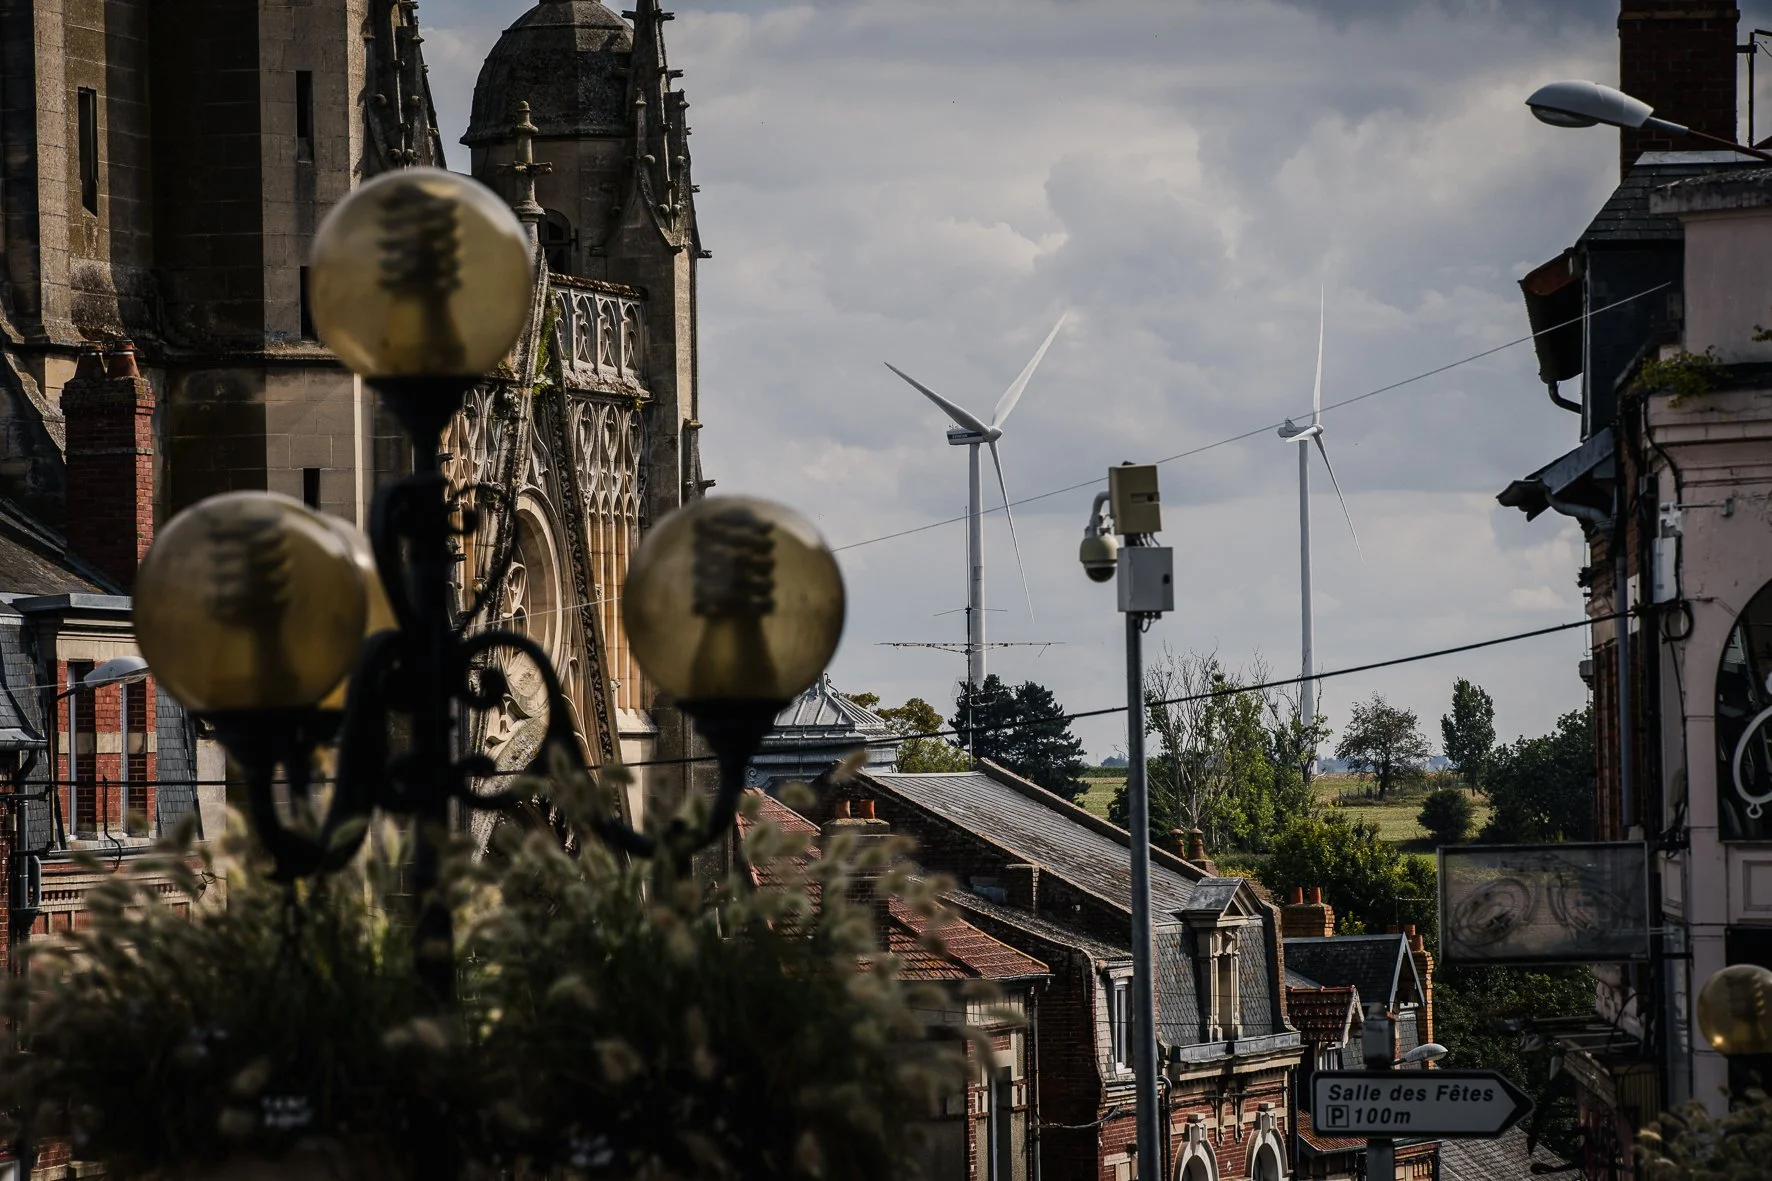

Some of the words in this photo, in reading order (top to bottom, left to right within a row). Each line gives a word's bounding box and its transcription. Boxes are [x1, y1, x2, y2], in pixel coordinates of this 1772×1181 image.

[1328, 1084, 1381, 1101] Salle
[1389, 1084, 1427, 1101] des
[1435, 1084, 1494, 1101] Fêtes
[1331, 1108, 1344, 1125] P
[1355, 1108, 1411, 1124] 100m
